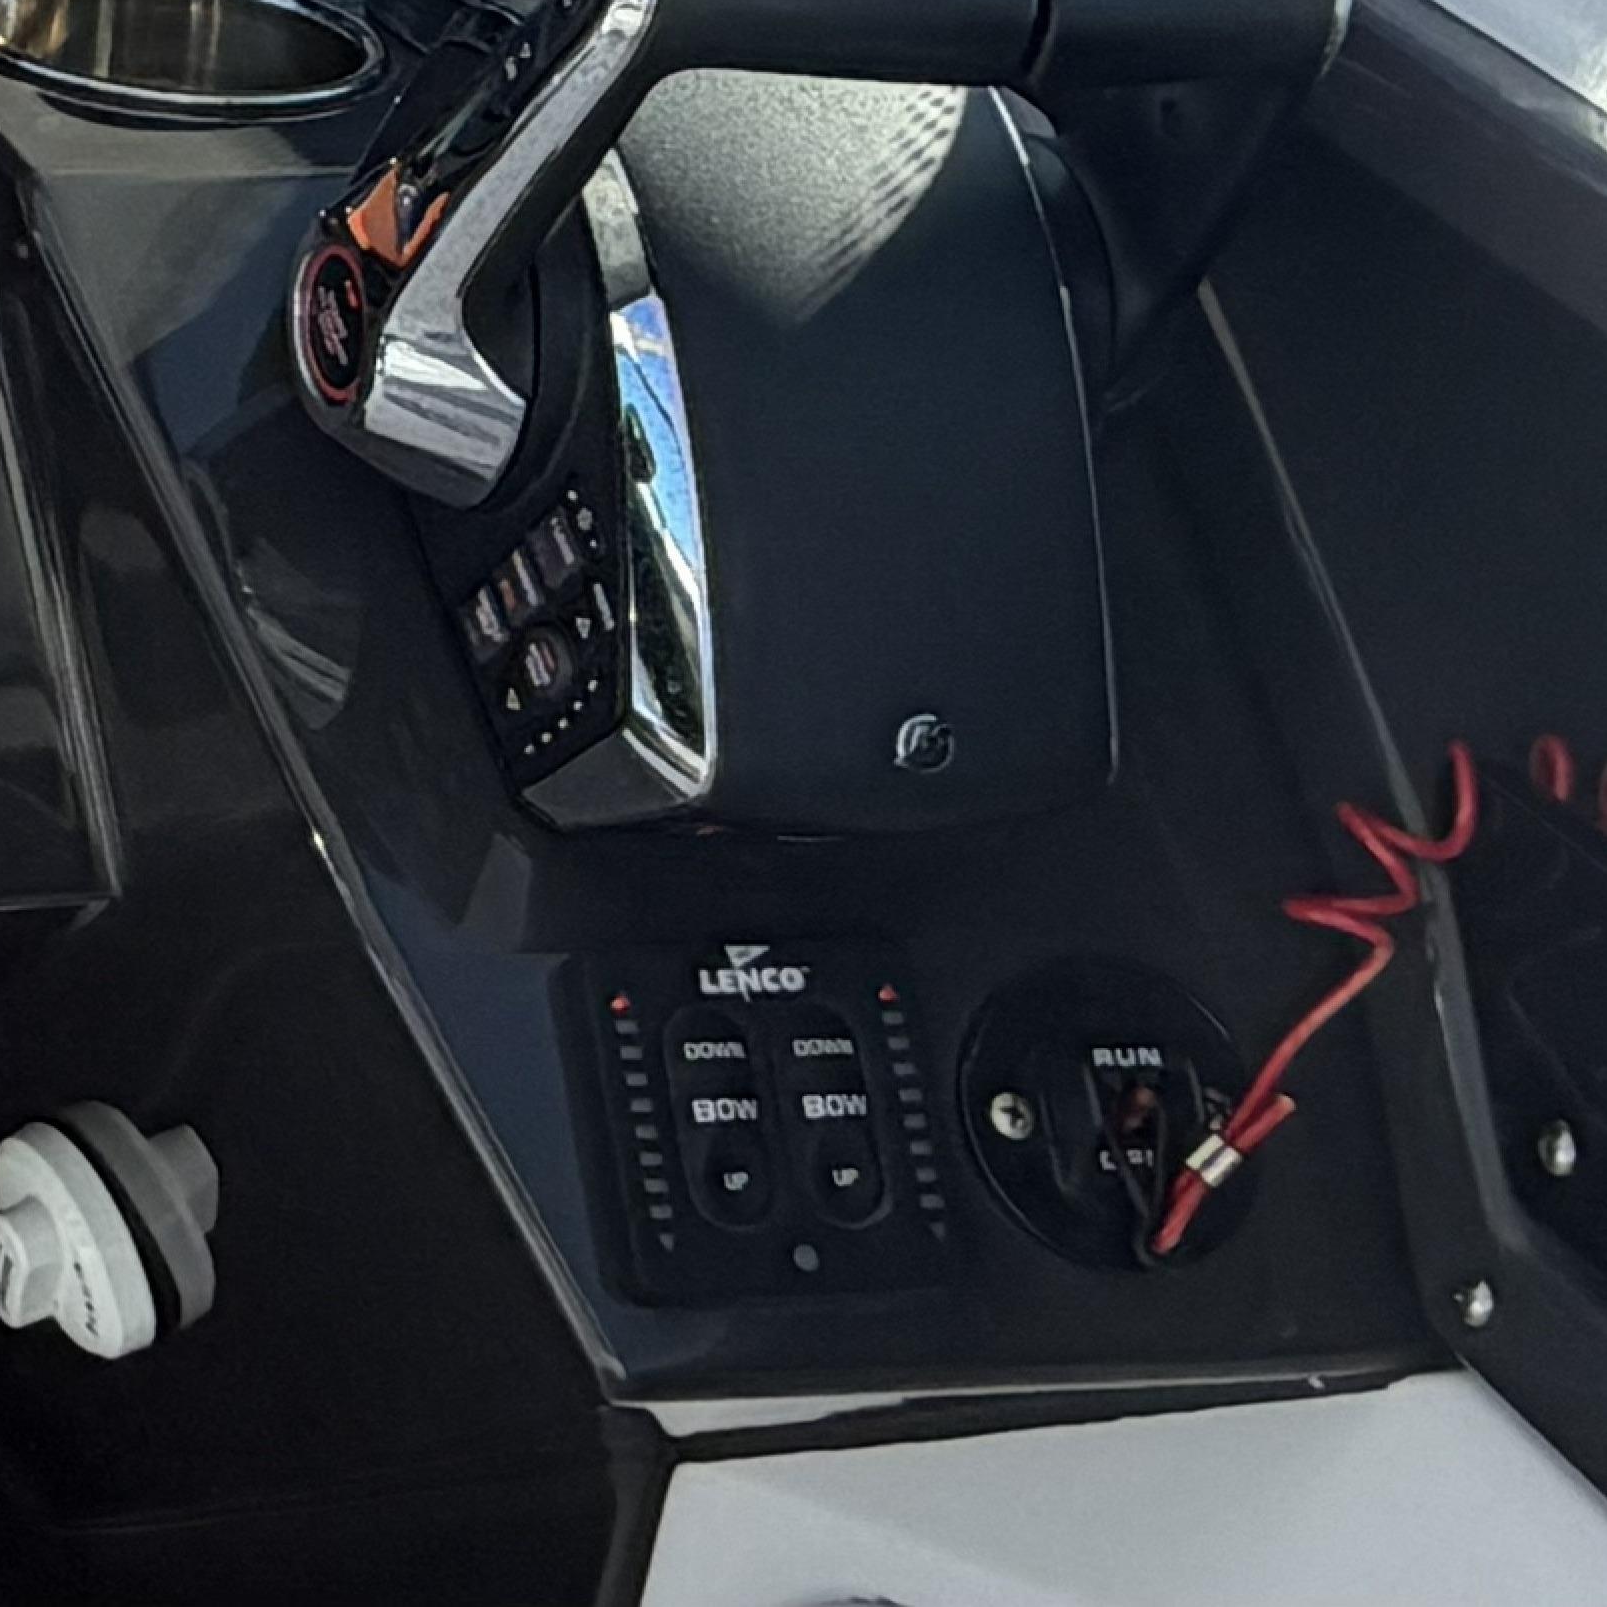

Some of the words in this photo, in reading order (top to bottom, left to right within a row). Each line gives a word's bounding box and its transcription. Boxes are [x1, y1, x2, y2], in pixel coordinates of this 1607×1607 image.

[698, 966, 808, 1002] LENCO
[1091, 1047, 1164, 1067] RUN
[691, 1098, 758, 1123] BOW
[801, 1093, 868, 1120] BOW
[723, 1171, 750, 1191] UP
[831, 1167, 860, 1187] UP
